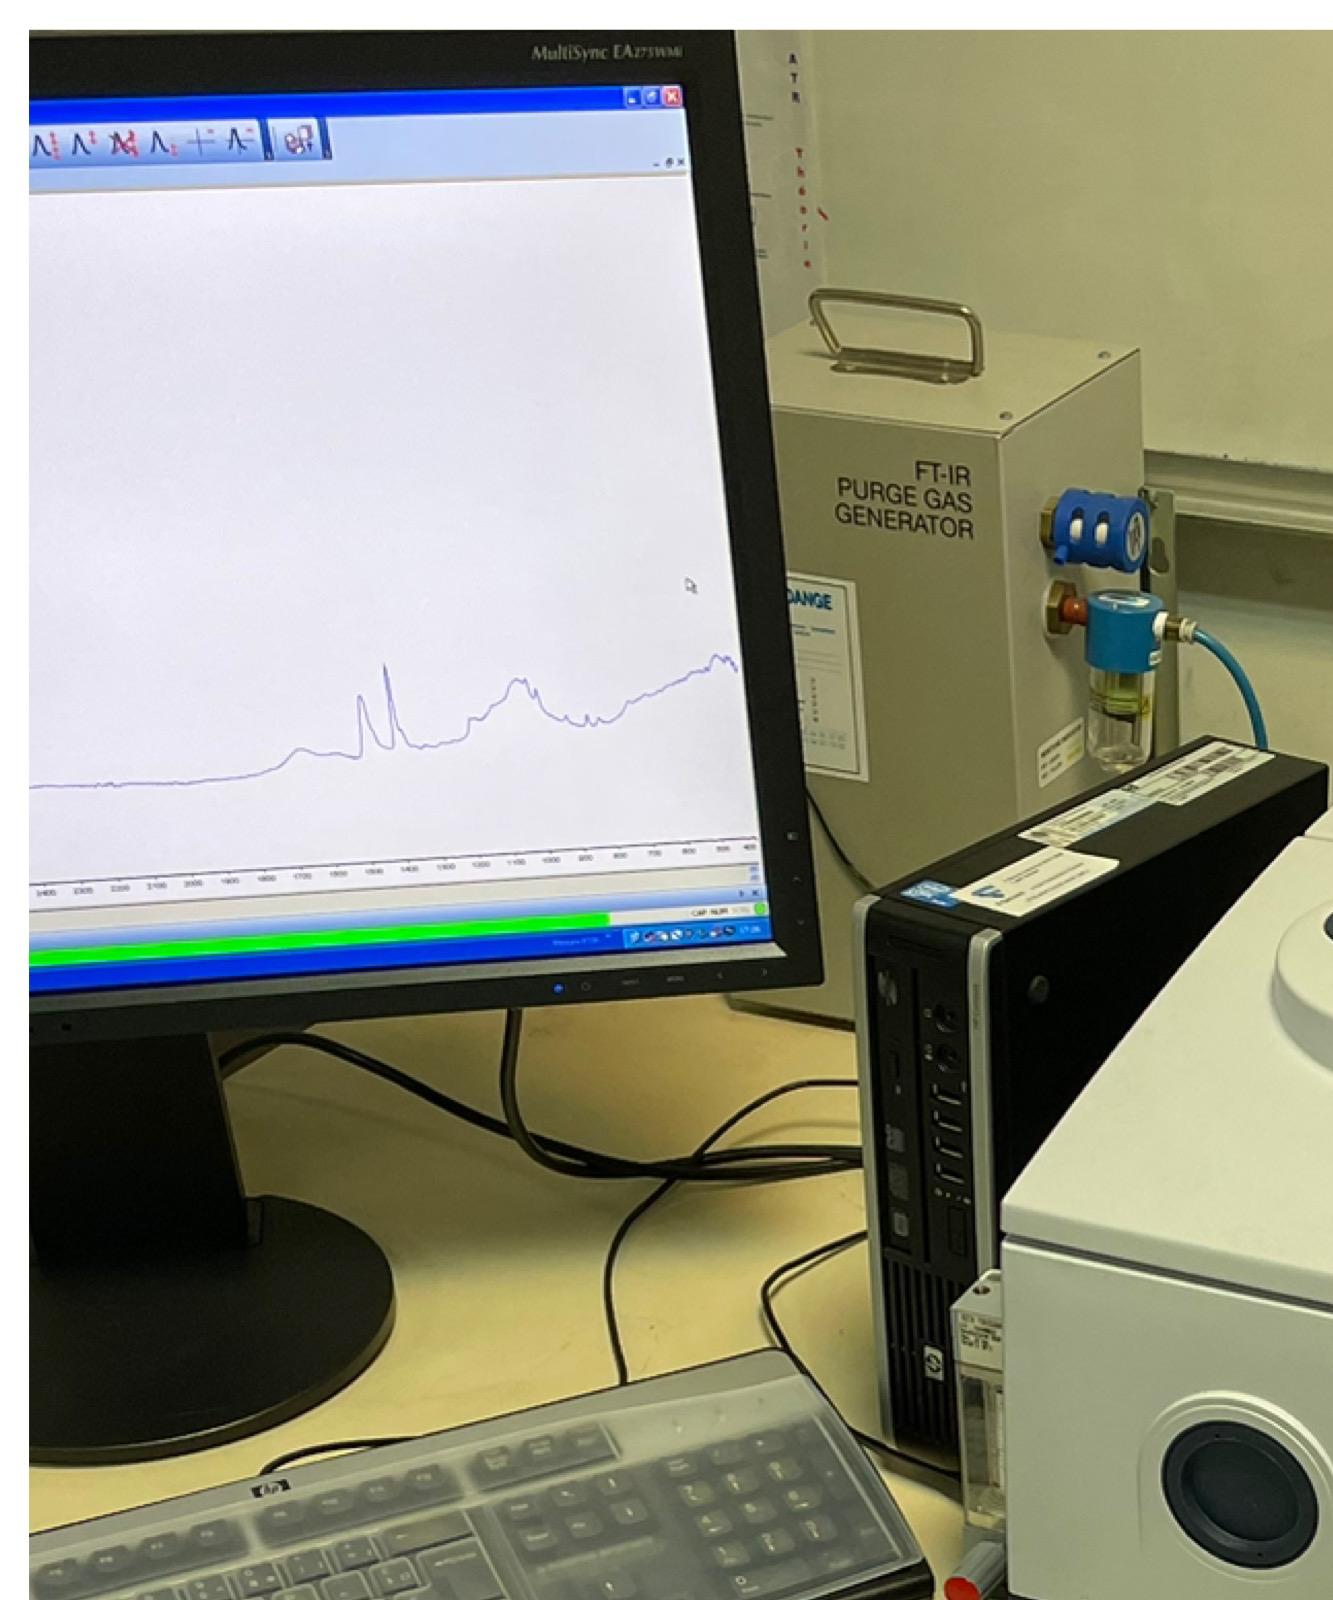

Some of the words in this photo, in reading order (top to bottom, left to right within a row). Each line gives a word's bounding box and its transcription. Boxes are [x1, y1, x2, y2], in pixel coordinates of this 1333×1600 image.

[531, 44, 609, 63] MultiSync
[915, 460, 972, 487] FT-IR
[837, 476, 918, 508] PURGE
[923, 488, 974, 514] GAS
[834, 503, 975, 541] GENERATOR
